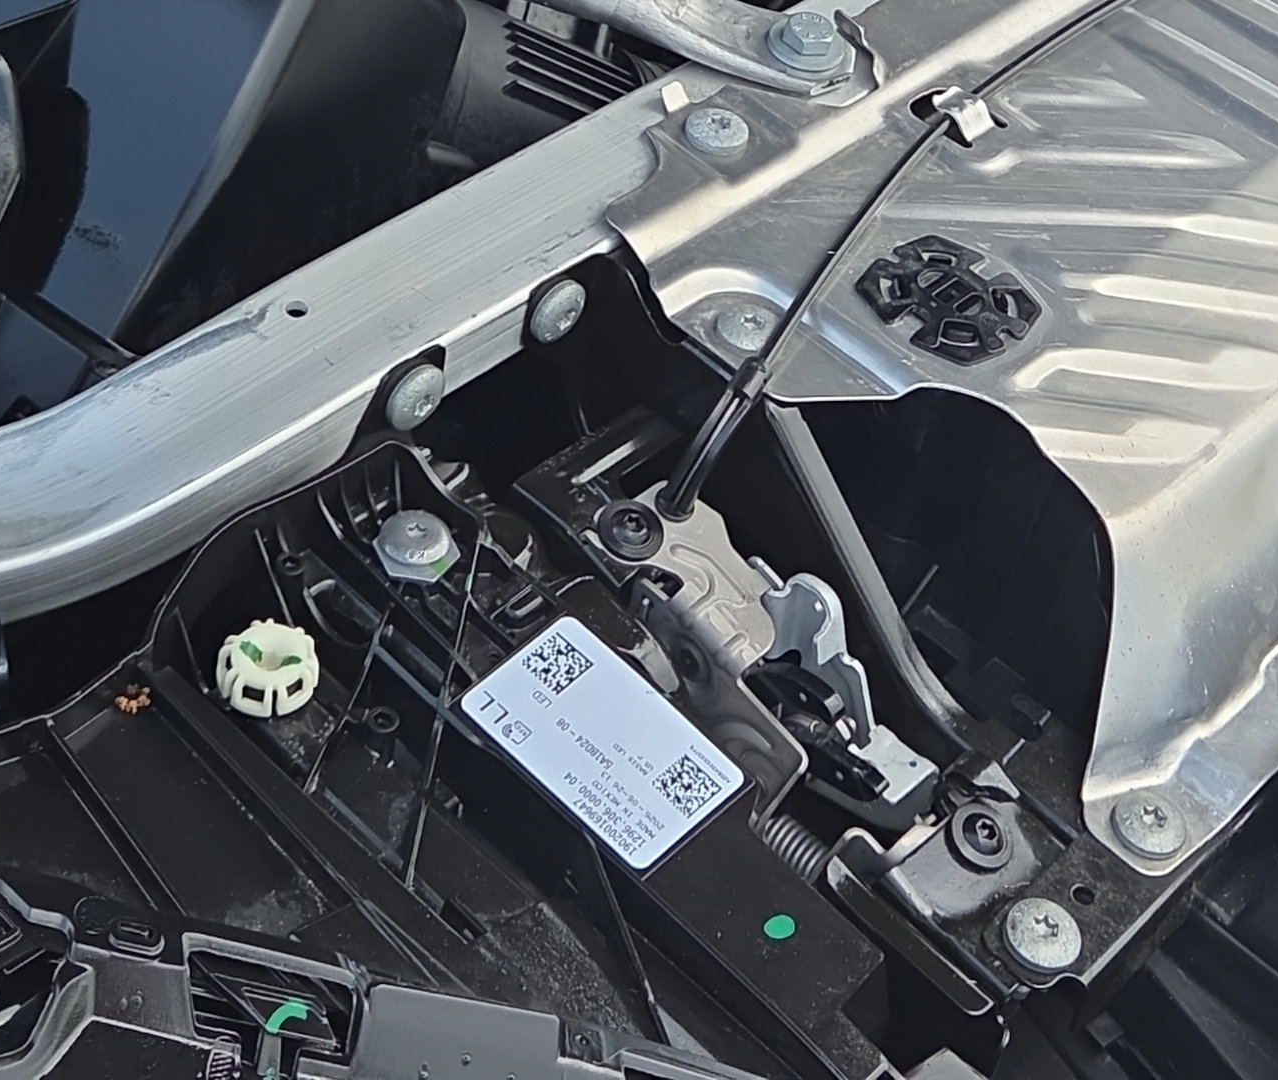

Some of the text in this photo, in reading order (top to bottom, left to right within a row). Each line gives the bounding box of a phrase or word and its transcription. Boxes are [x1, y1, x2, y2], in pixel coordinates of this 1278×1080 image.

[477, 690, 509, 724] LL
[590, 778, 622, 806] MEXICO
[572, 797, 637, 855] 190200169647
[634, 818, 657, 839] MADE
